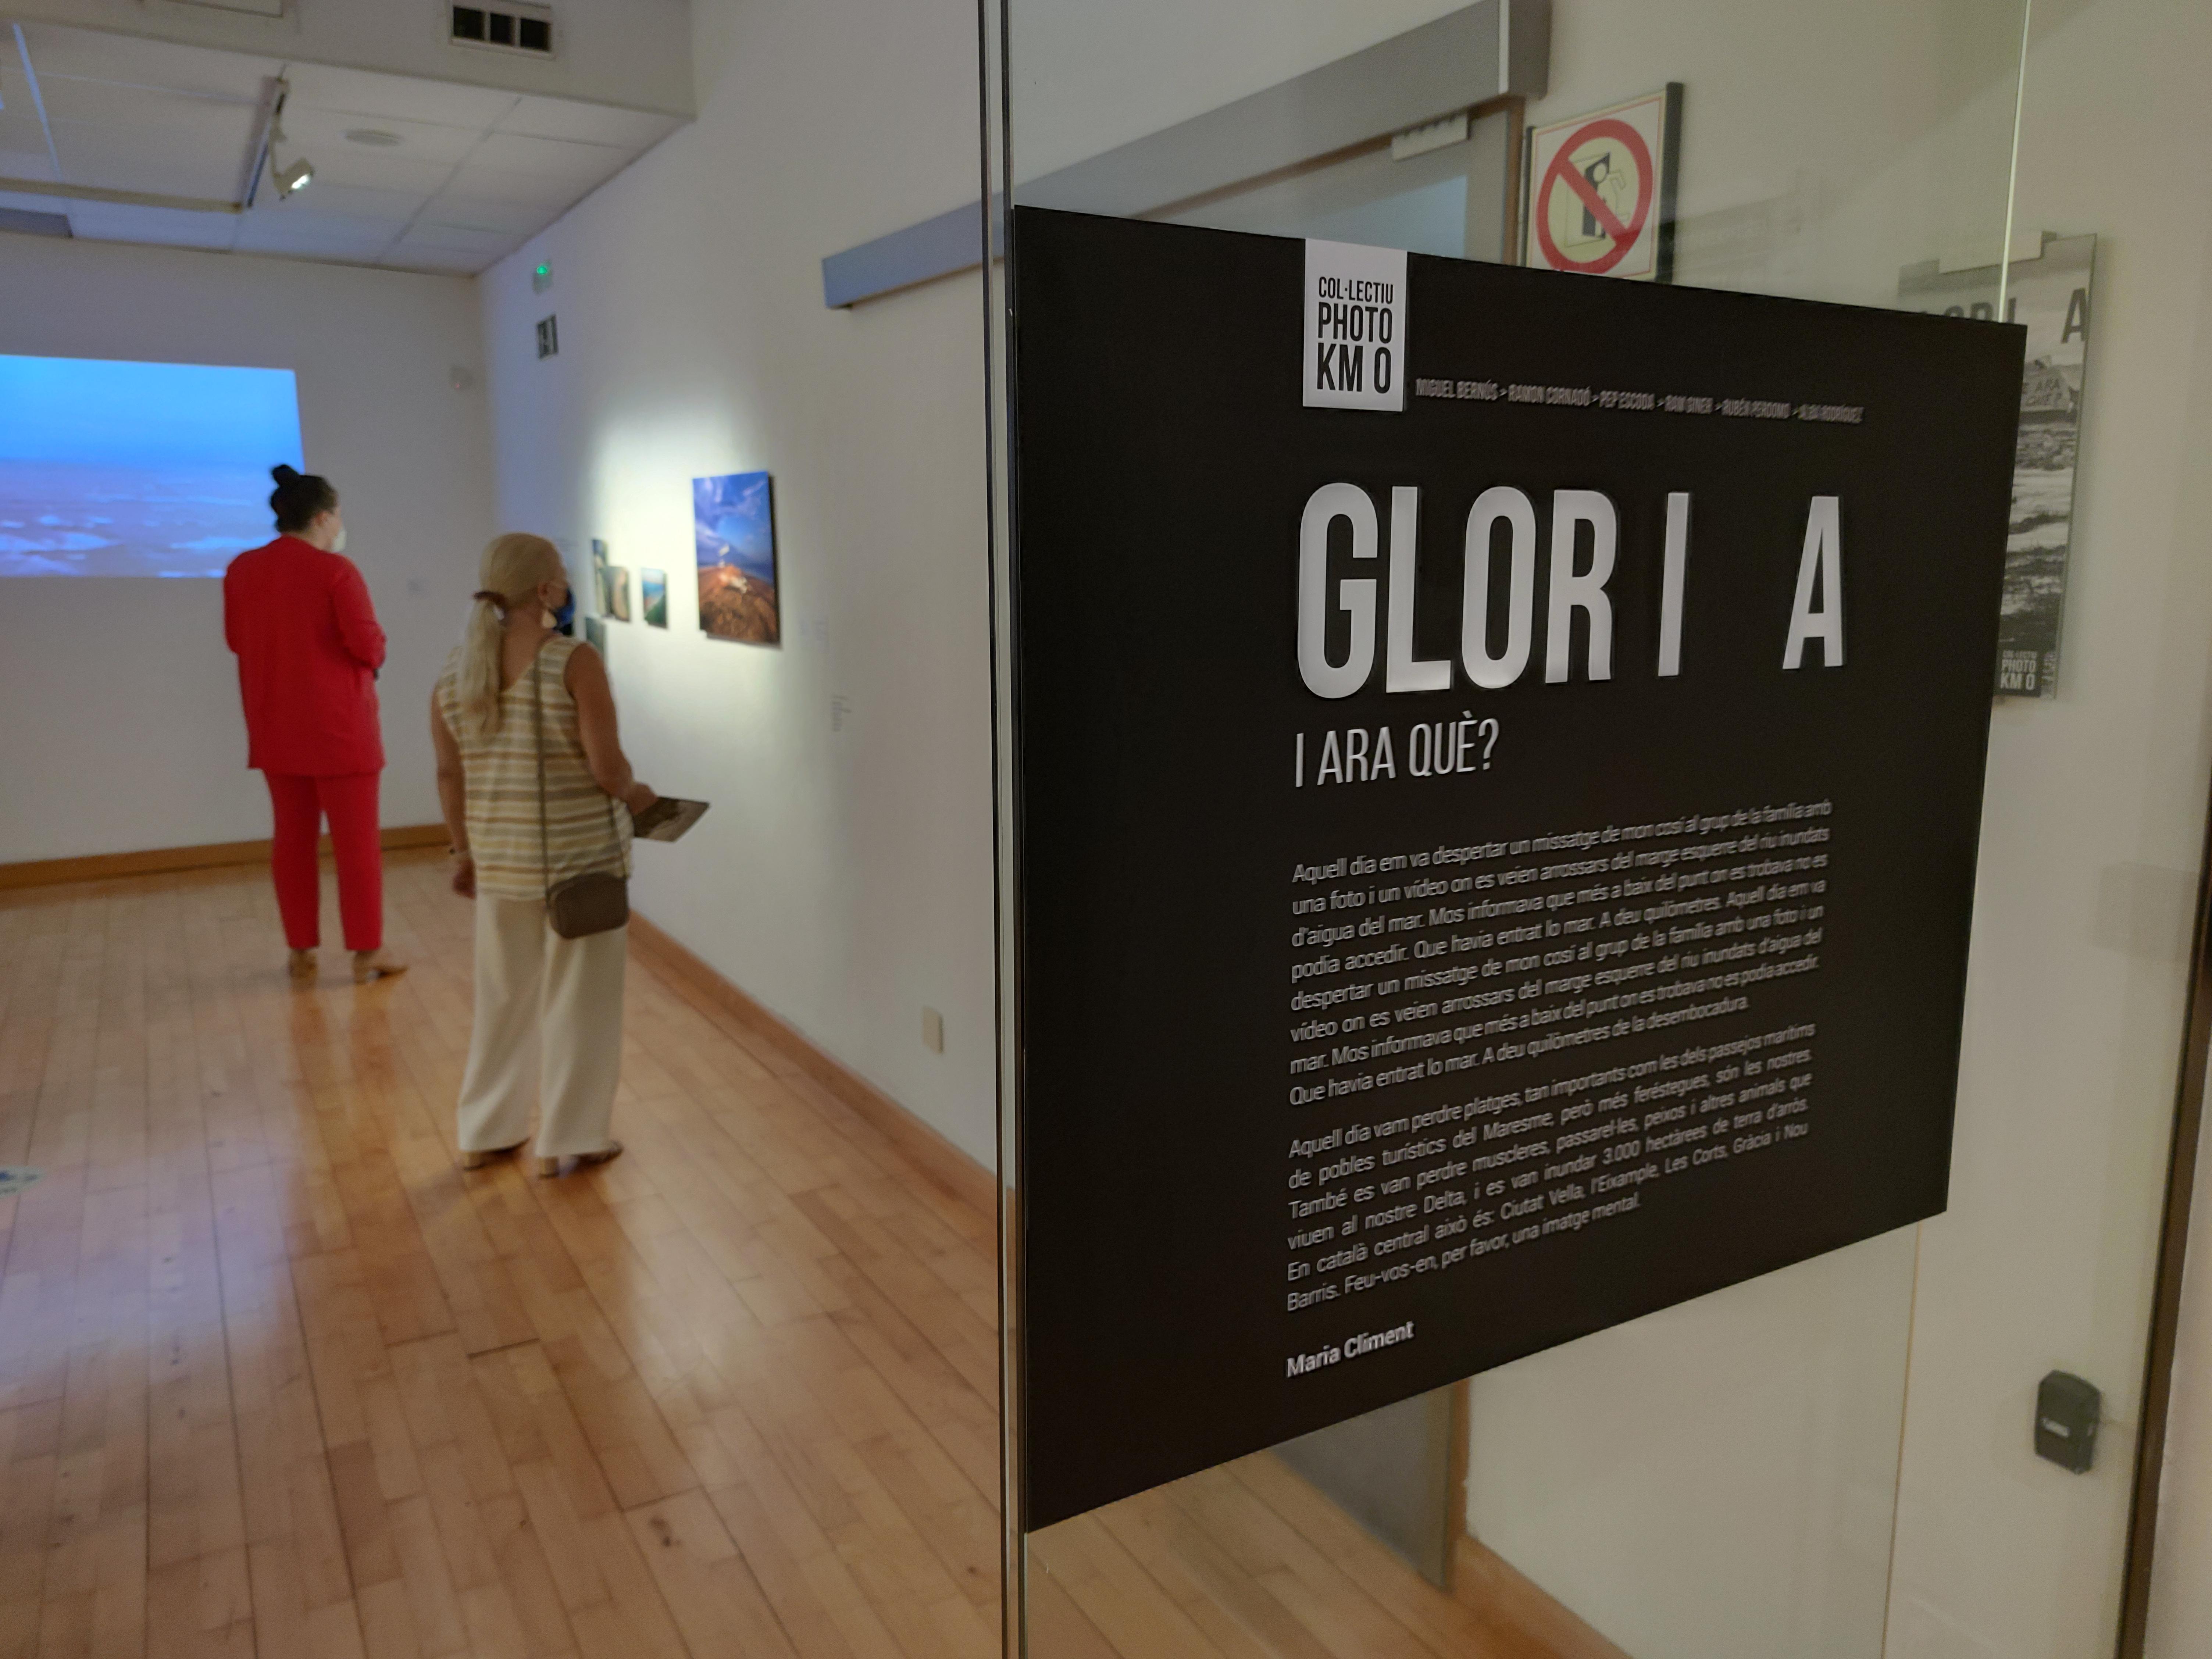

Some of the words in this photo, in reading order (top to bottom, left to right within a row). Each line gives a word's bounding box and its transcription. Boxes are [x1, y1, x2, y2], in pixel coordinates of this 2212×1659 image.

[1319, 276, 1393, 304] COL·LECTIU
[1318, 302, 1392, 344] PHOTO
[1317, 343, 1363, 392] KM
[2000, 673, 2022, 689] KM
[2001, 659, 2036, 673] PHOTO
[1296, 733, 1304, 787] I
[1317, 726, 1396, 786] ARA
[1409, 710, 1500, 778] QUÈ?
[1292, 857, 1347, 884] Aquell
[1379, 855, 1407, 871] em
[1409, 852, 1430, 867] va
[1292, 897, 1326, 914] una
[1330, 890, 1366, 909] foto
[1368, 885, 1375, 904] i
[1378, 887, 1401, 903] un
[1451, 877, 1472, 892] on
[1291, 924, 1355, 947] d'aigua
[1358, 915, 1385, 936] del
[1345, 943, 1408, 970] accedir.
[1413, 940, 1447, 958] Que
[1291, 984, 1372, 1010] despertar
[1377, 979, 1400, 995] un
[1404, 966, 1477, 989] missatge
[1290, 1020, 1338, 1041] vídeo
[1341, 1016, 1365, 1032] on
[1369, 1011, 1390, 1027] es
[1394, 1001, 1437, 1021] veien
[1289, 1054, 1328, 1074] mar.
[1331, 1046, 1369, 1065] Mos
[1371, 1030, 1452, 1057] informava
[1289, 1085, 1326, 1105] Que
[1328, 1073, 1373, 1096] havia
[1376, 1062, 1424, 1086] entrat
[1427, 1058, 1443, 1075] lo
[1289, 1128, 1342, 1158] Aquell
[1344, 1124, 1371, 1144] dia
[1373, 1118, 1409, 1137] vam
[1411, 1104, 1462, 1132] perdre
[1464, 1092, 1521, 1120] platges,
[1524, 1085, 1549, 1102] tan
[1551, 1067, 1626, 1095] importants
[1627, 1060, 1658, 1078] com
[1659, 1054, 1679, 1070] les
[1680, 1046, 1707, 1066] dels
[1288, 1168, 1312, 1189] de
[1319, 1155, 1375, 1185] pobles
[1382, 1138, 1446, 1165] turístics
[1452, 1126, 1477, 1148] del
[1483, 1113, 1553, 1139] Maresme,
[1560, 1099, 1593, 1125] però
[1289, 1188, 1348, 1218] També
[1353, 1185, 1375, 1202] es
[1380, 1176, 1411, 1194] van
[1416, 1161, 1467, 1190] perdre
[1472, 1141, 1550, 1171] muscleres,
[1644, 1105, 1686, 1130] peixos
[1690, 1098, 1695, 1114] i
[1288, 1226, 1334, 1249] viuen
[1341, 1214, 1358, 1235] al
[1365, 1204, 1417, 1228] nostre
[1424, 1191, 1466, 1213] Delta,
[1474, 1182, 1480, 1199] i
[1485, 1180, 1505, 1196] es
[1510, 1171, 1538, 1188] van
[1544, 1155, 1596, 1179] inundar
[1602, 1140, 1640, 1164] 3.000
[1287, 1261, 1310, 1281] En
[1316, 1242, 1368, 1272] català
[1374, 1224, 1429, 1255] central
[1434, 1214, 1467, 1239] això
[1500, 1195, 1544, 1219] Ciutat
[1665, 1156, 1688, 1174] Les
[1287, 1283, 1340, 1311] Barris.
[1345, 1256, 1438, 1293] Feu-vos-en,
[1441, 1246, 1467, 1269] per
[1470, 1234, 1509, 1256] favor,
[1512, 1225, 1540, 1244] una
[1542, 1210, 1590, 1234] imatge
[1287, 1345, 1341, 1377] Maria
[1344, 1321, 1414, 1357] Climent
